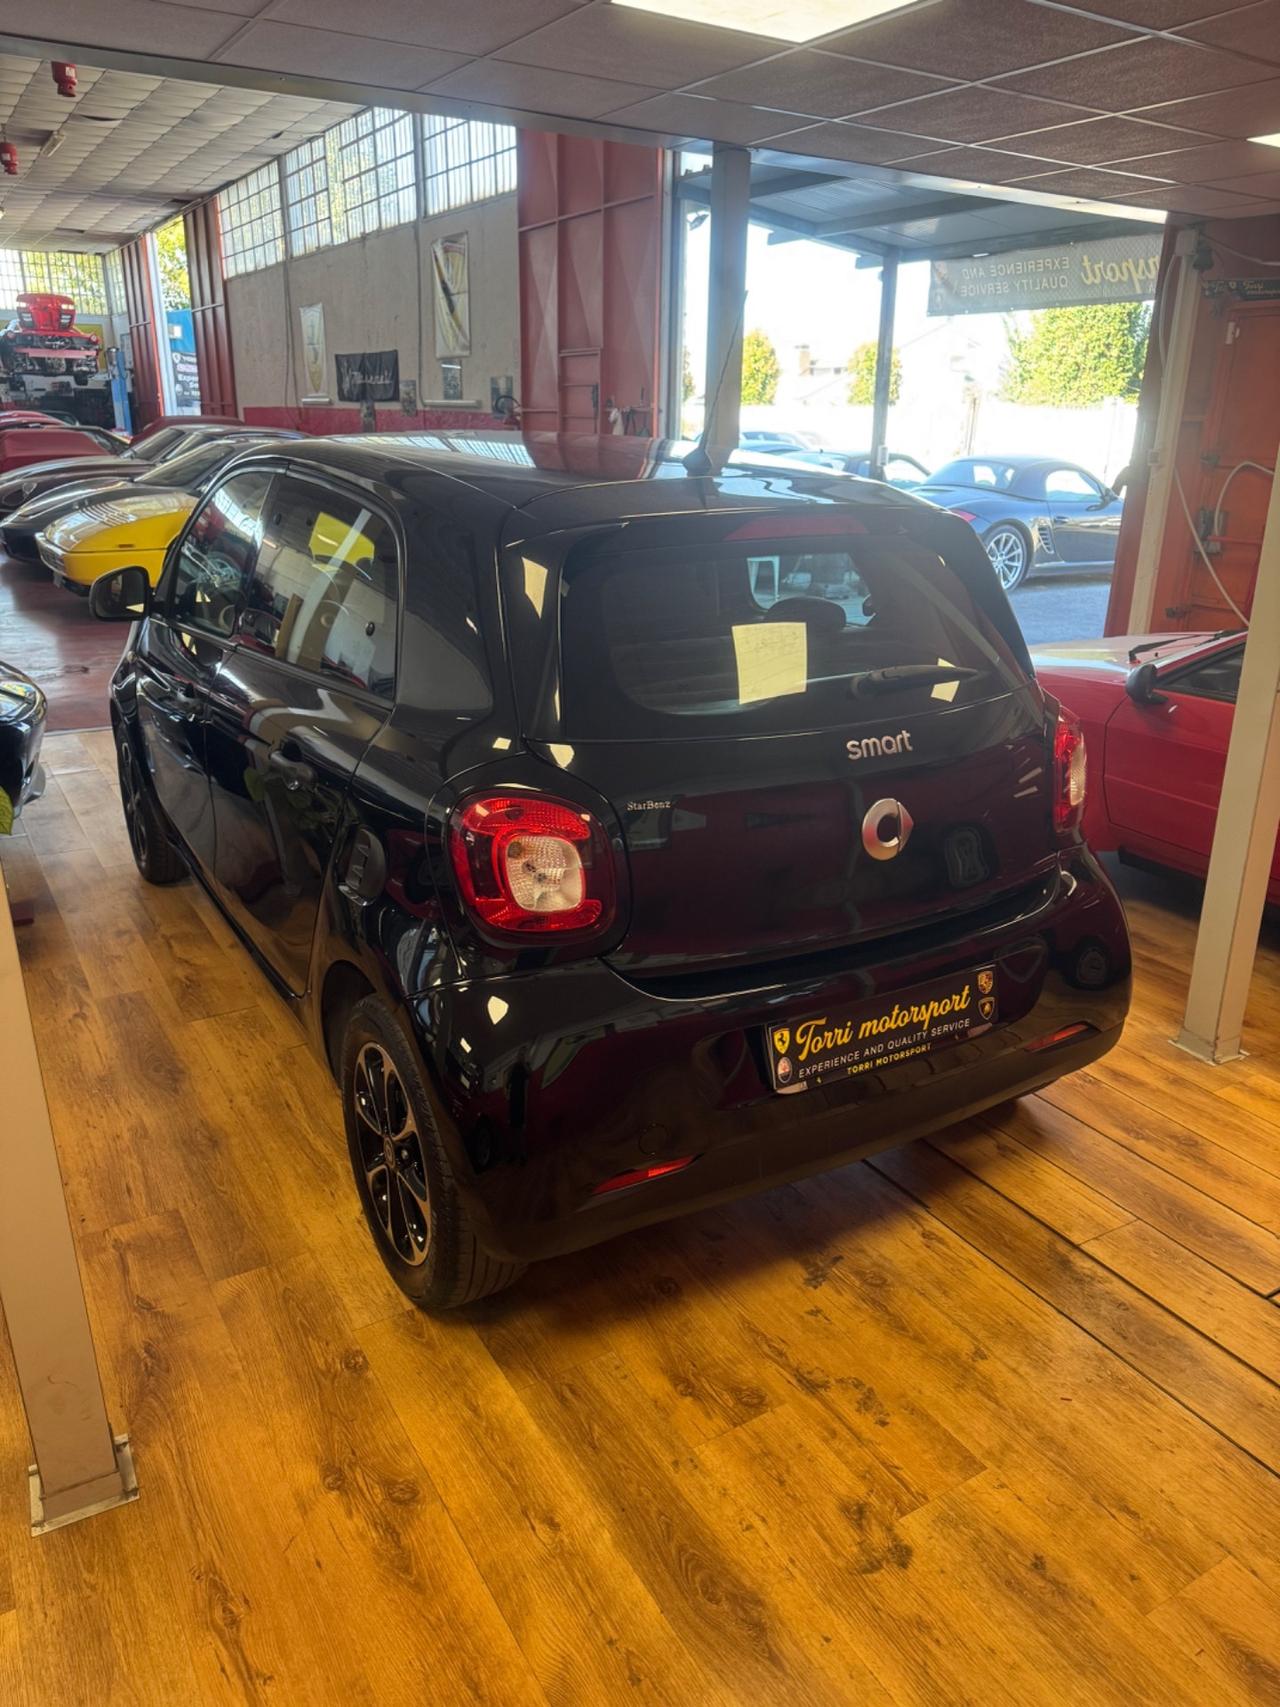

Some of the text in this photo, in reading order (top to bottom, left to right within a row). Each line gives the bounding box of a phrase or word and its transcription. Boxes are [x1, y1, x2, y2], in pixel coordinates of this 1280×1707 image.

[846, 730, 913, 760] smart
[627, 800, 671, 811] StarBenz
[795, 985, 971, 1061] Torri motorsport
[799, 1018, 971, 1078] EXPERIENCE AND QUALITY SERVICE
[847, 1043, 932, 1075] TORRI MOTORSPORT
